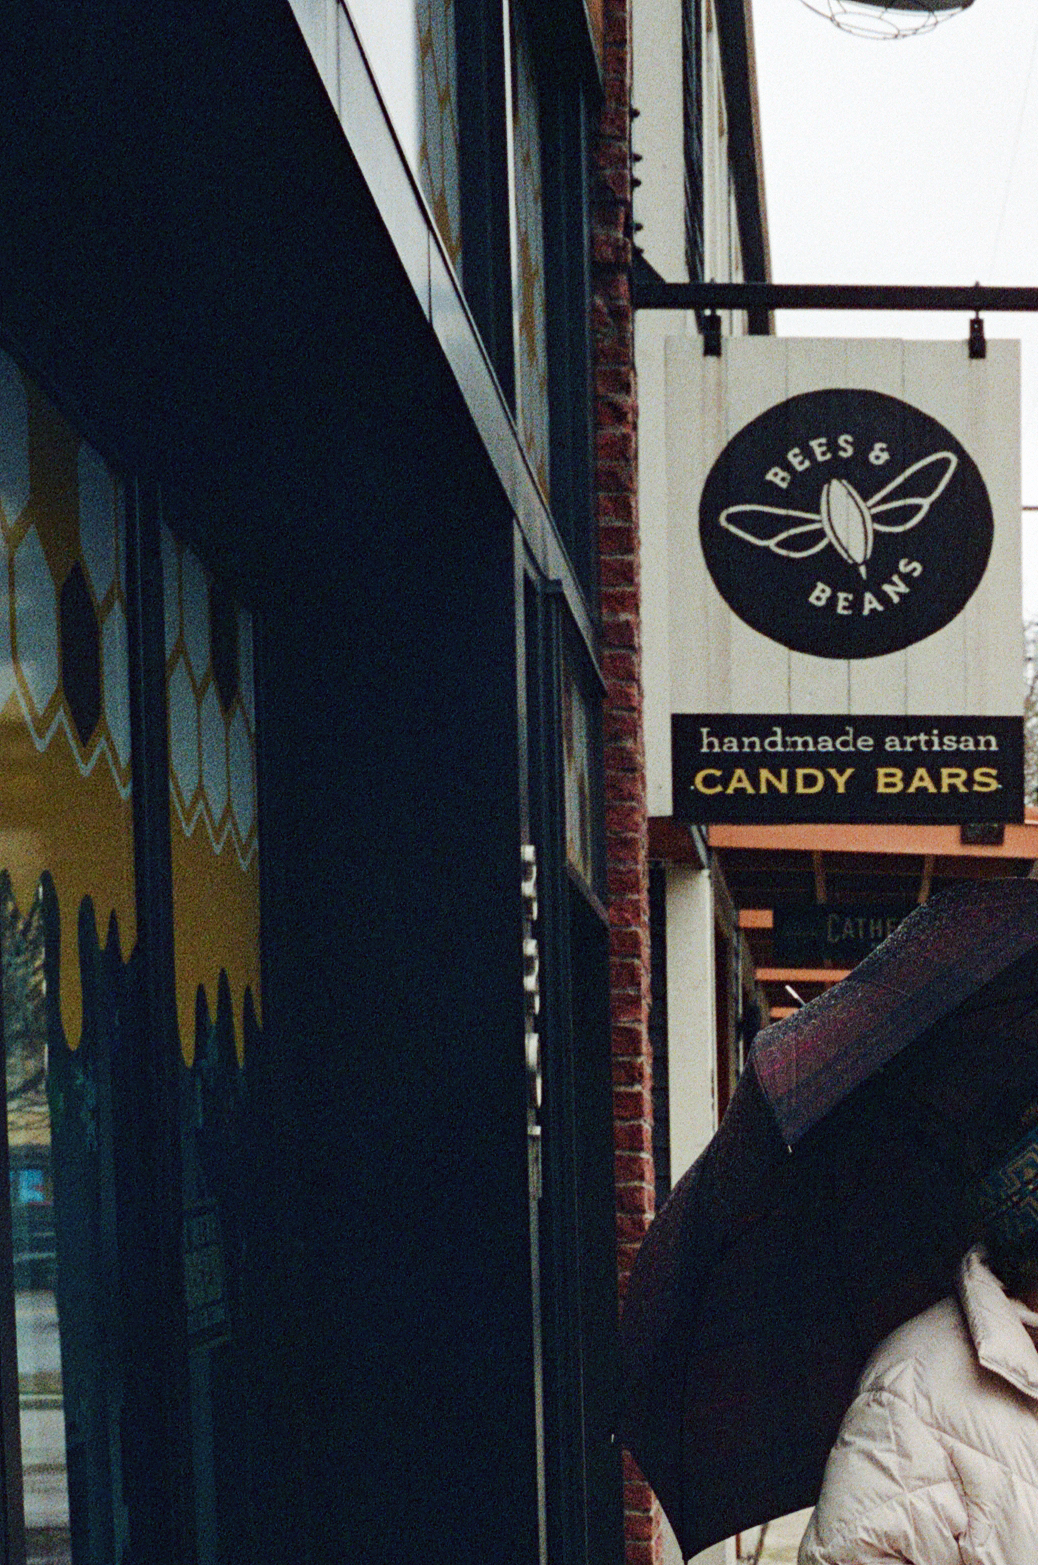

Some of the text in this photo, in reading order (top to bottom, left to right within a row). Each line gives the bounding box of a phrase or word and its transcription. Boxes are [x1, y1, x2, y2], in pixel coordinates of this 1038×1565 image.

[764, 434, 890, 489] BEES &
[808, 558, 923, 616] BEANS
[700, 727, 999, 753] handmade artisan
[694, 766, 998, 794] CANDY BARS
